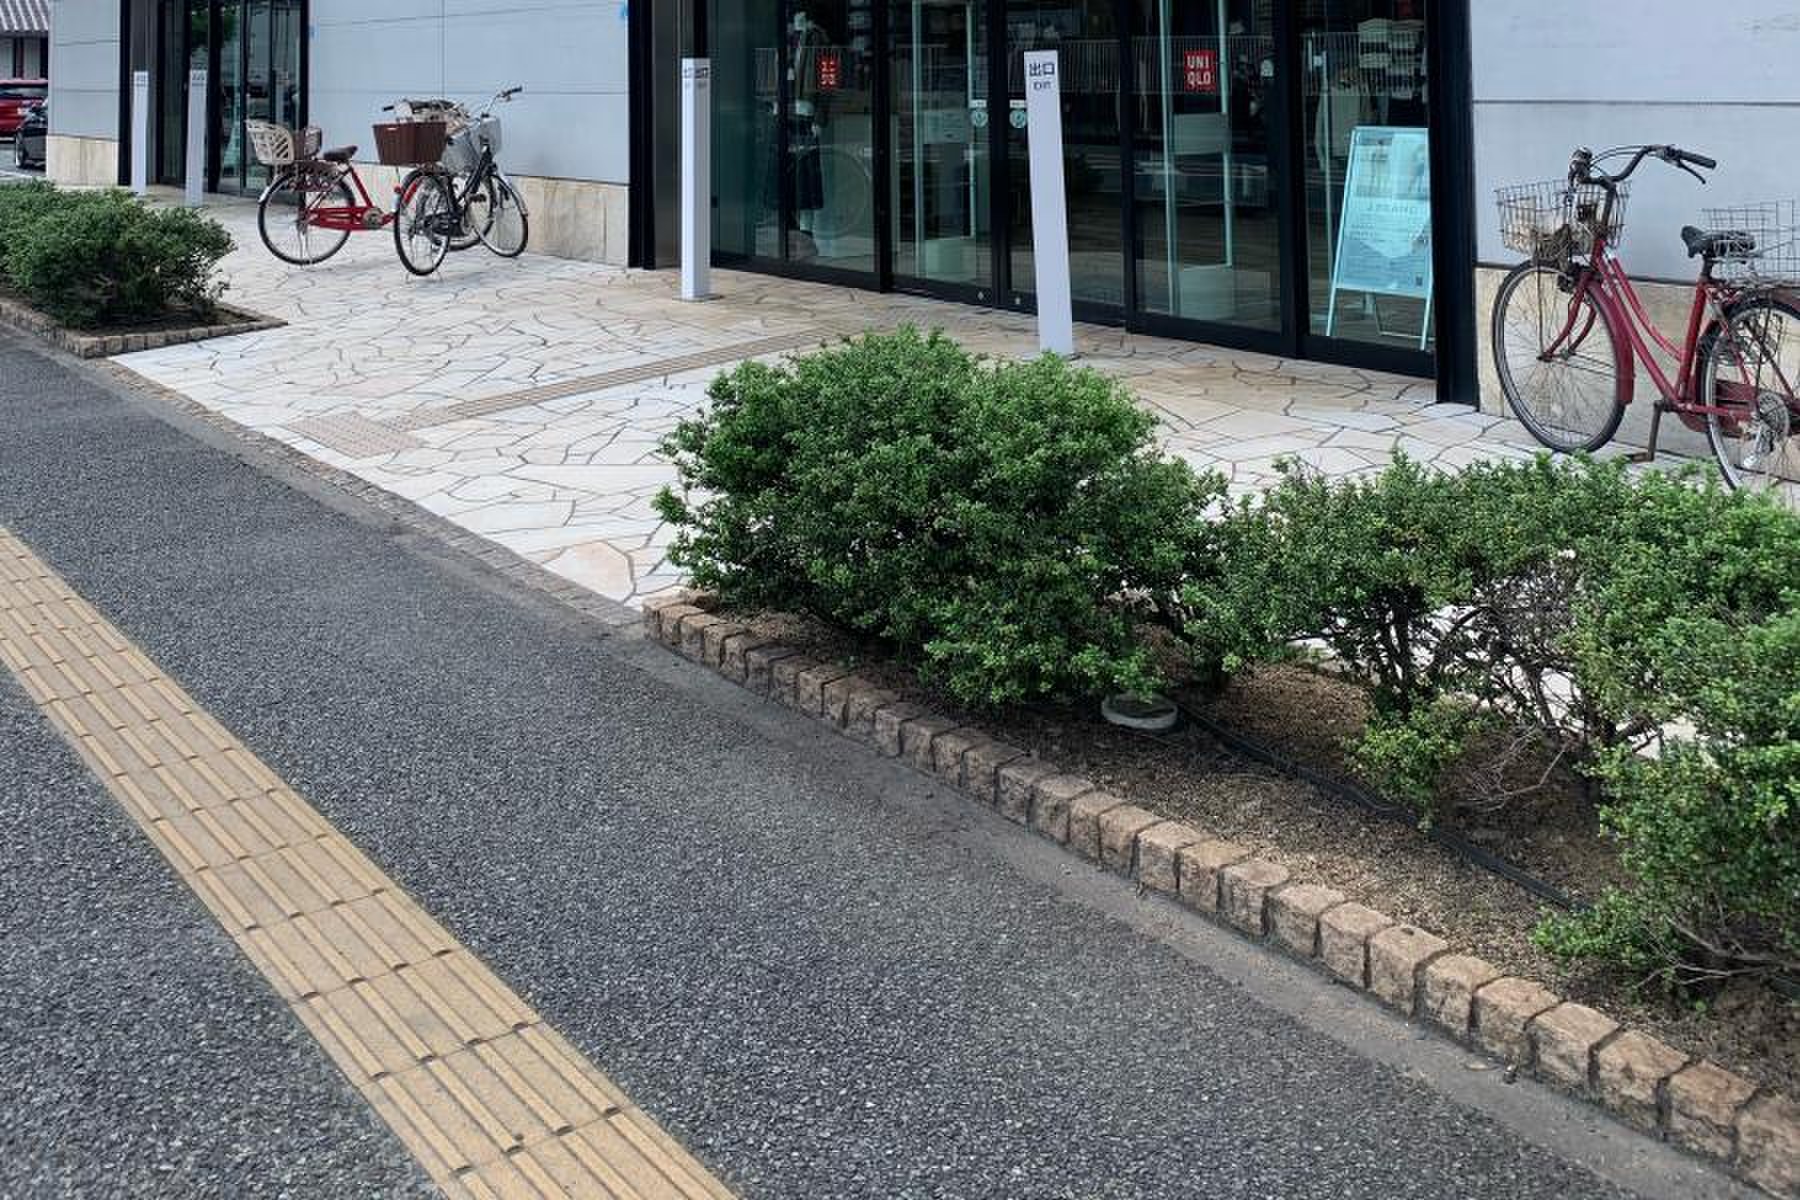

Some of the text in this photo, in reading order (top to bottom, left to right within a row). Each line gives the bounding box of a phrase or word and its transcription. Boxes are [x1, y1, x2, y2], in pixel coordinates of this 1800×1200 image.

[1029, 61, 1055, 77] 出口
[1186, 55, 1210, 69] UNI
[1186, 71, 1211, 88] QLO
